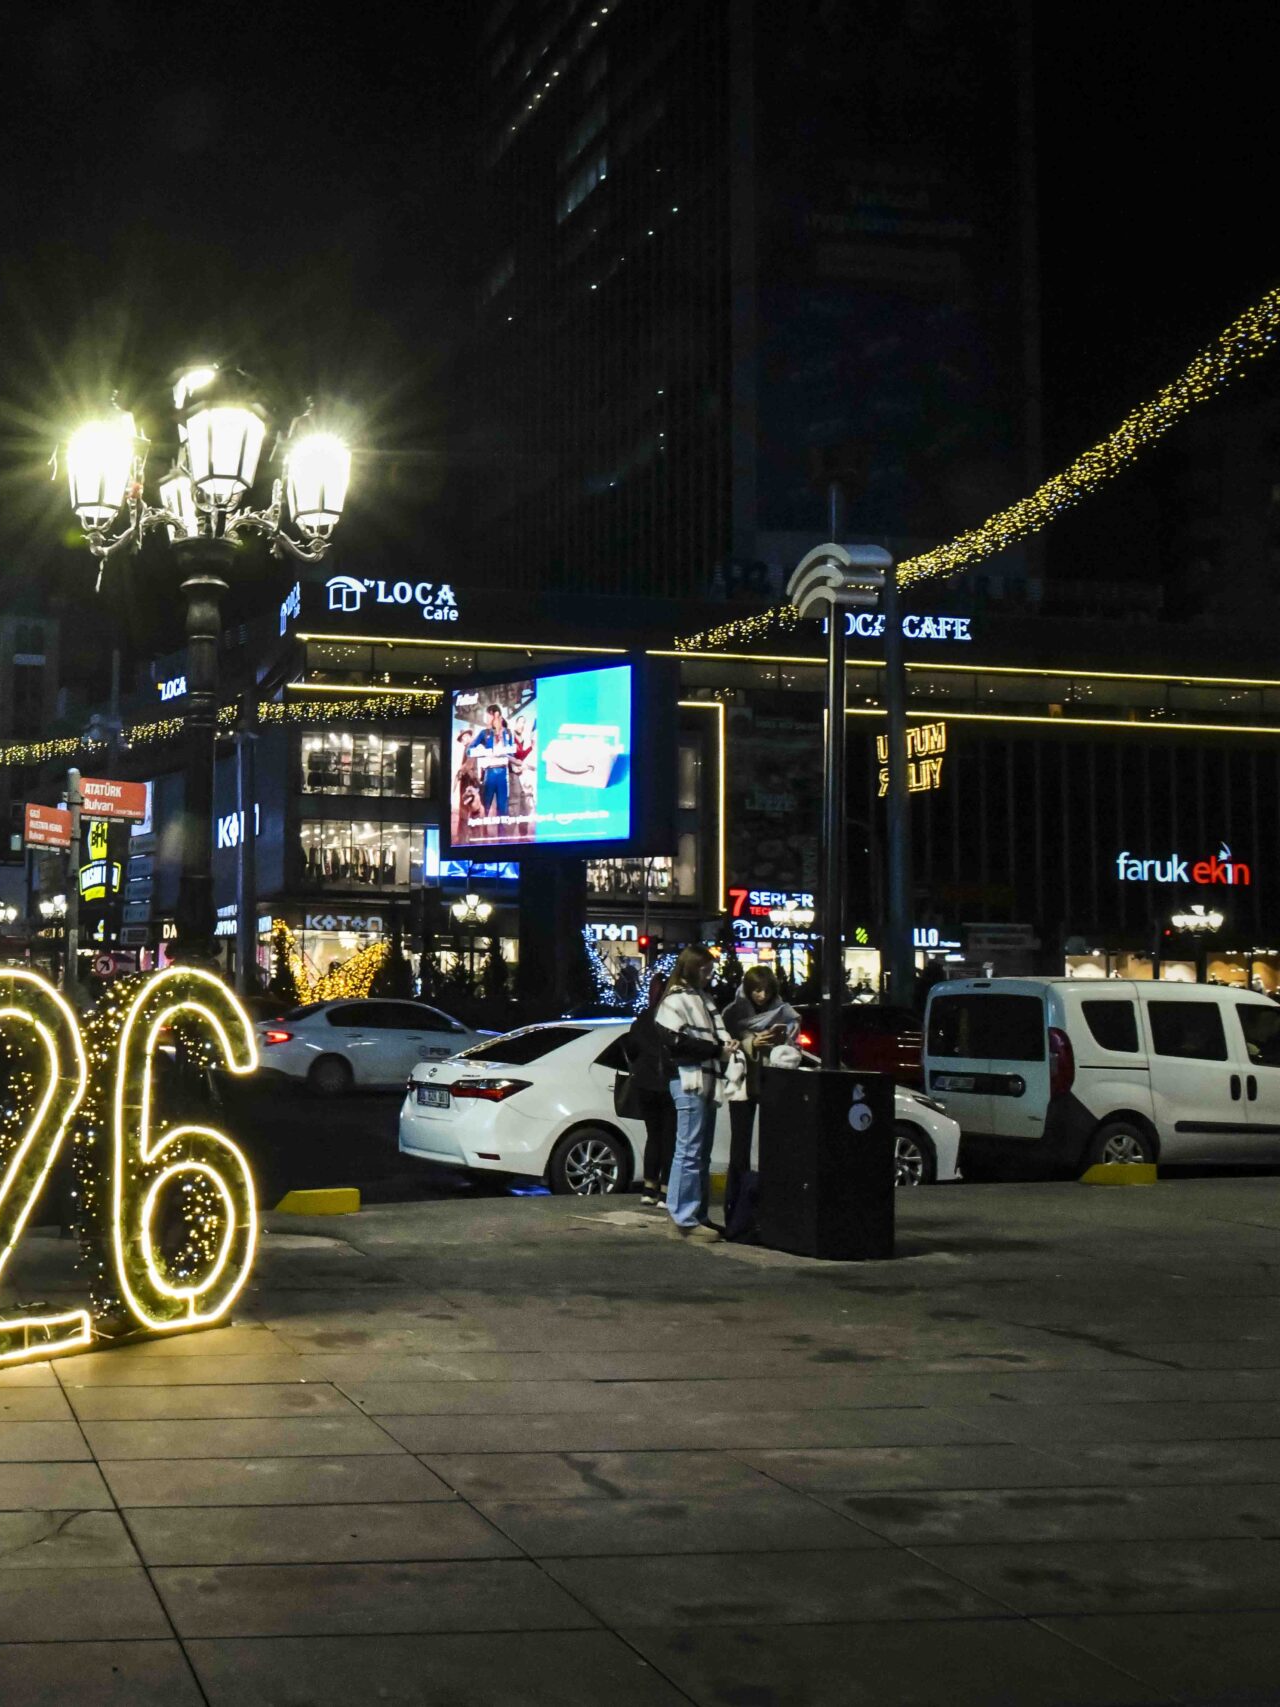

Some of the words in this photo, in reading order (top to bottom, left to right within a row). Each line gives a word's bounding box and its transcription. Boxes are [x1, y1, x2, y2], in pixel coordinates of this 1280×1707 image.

[376, 580, 458, 606] LOCA
[422, 605, 459, 621] Cafe
[902, 615, 972, 640] CAFE
[161, 676, 187, 701] LOCA
[83, 782, 122, 798] ATATÜRK
[83, 798, 114, 812] Bulvarı
[1116, 851, 1190, 883] faruk
[1192, 854, 1251, 885] ekin
[729, 889, 748, 917] 7
[754, 926, 790, 939] LOCA
